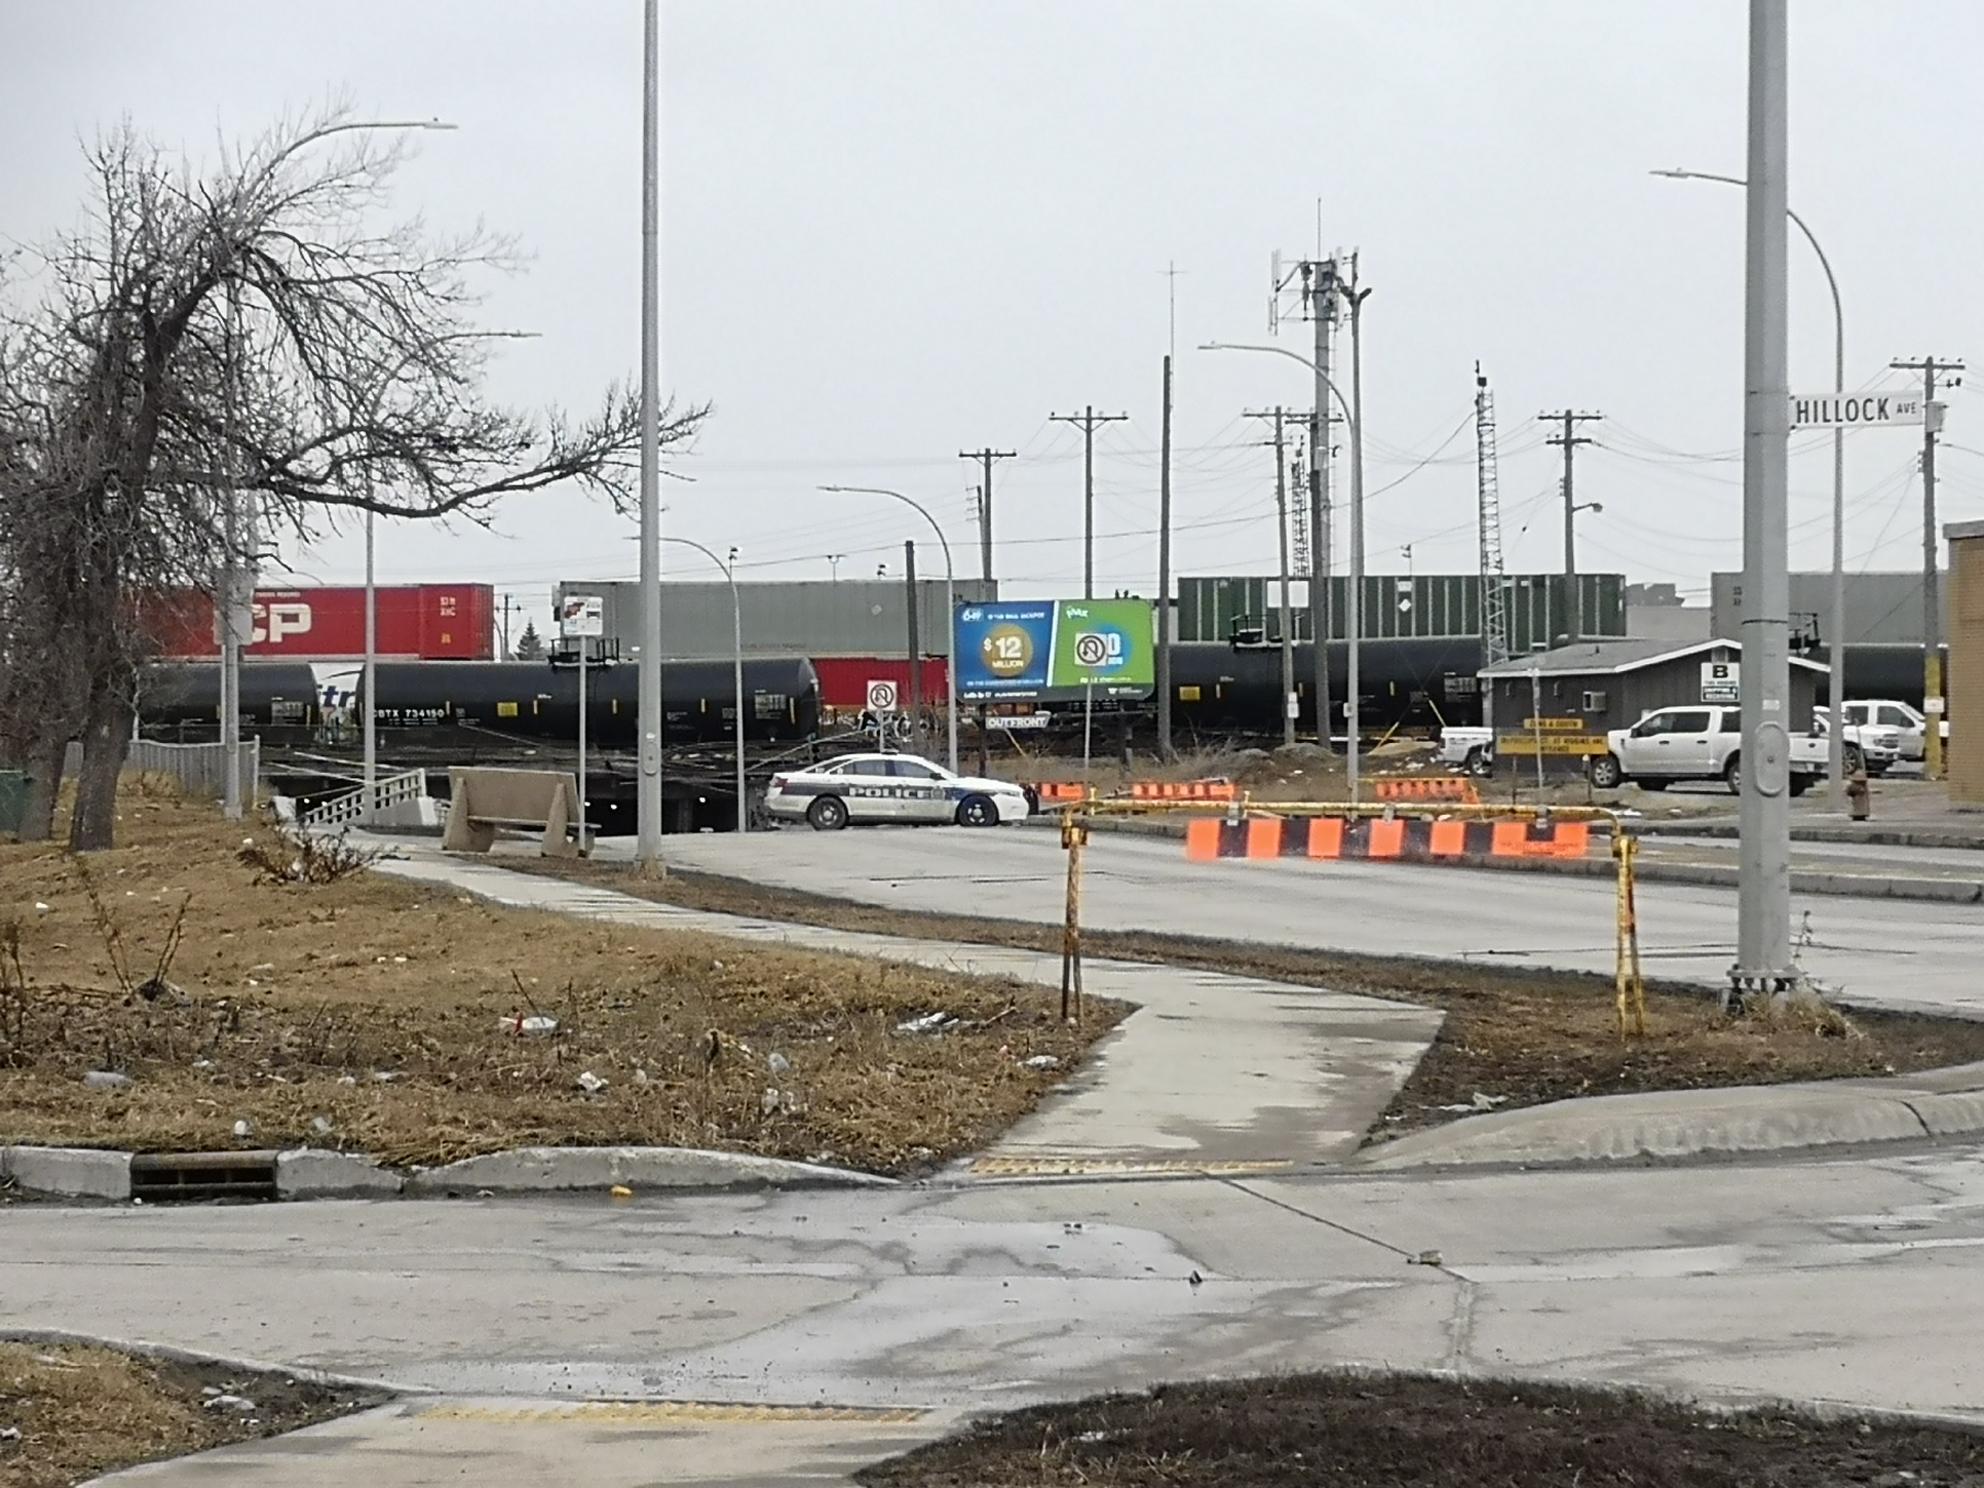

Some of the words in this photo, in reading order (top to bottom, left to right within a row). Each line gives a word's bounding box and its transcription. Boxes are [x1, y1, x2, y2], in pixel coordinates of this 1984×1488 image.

[1796, 398, 1889, 423] HILLOCK
[1896, 402, 1917, 414] AVE
[1712, 665, 1729, 678] B
[987, 717, 1048, 728] OUTFRONT
[849, 786, 930, 799] POLICE
